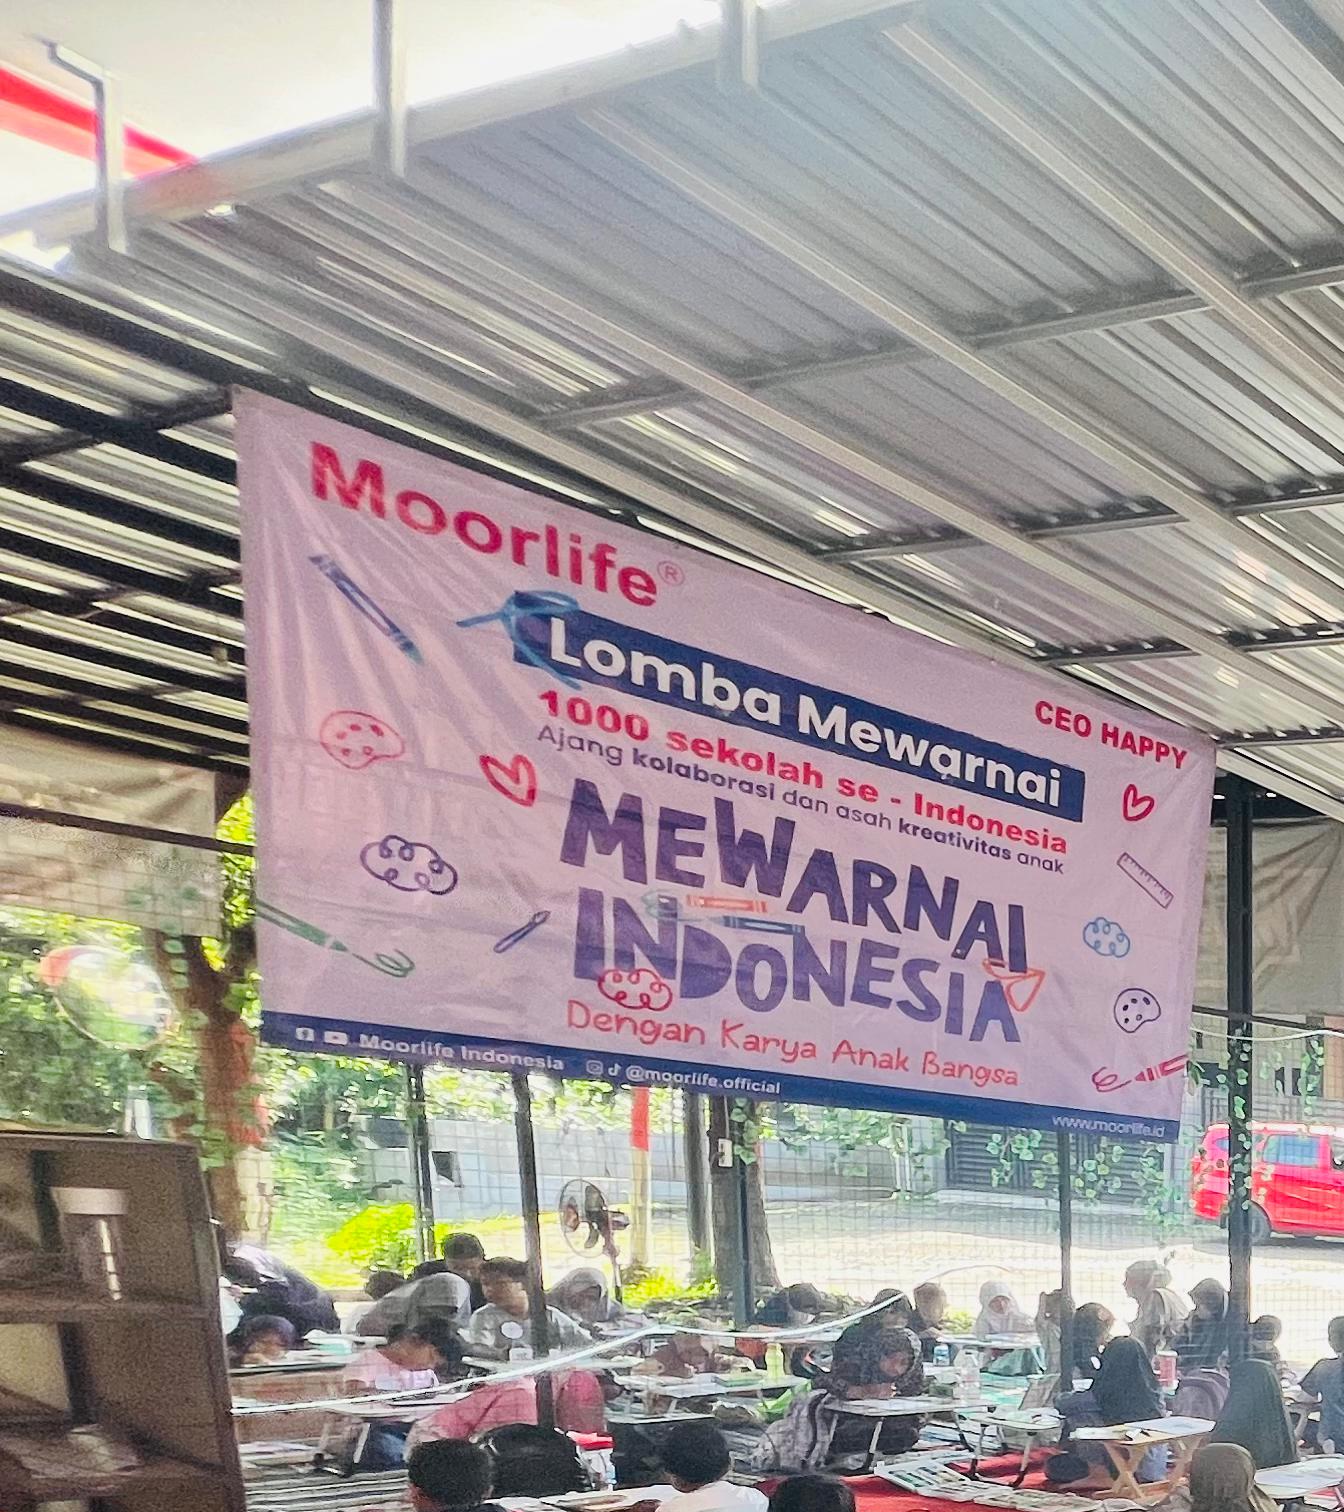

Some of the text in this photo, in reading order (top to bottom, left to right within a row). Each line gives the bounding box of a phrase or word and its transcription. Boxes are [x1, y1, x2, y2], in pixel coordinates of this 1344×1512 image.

[538, 689, 649, 741] 1000
[666, 727, 823, 789] sekolah
[836, 772, 878, 803] se
[914, 793, 1067, 853] Indonesia
[551, 618, 1061, 806] Lomba Mewarnai
[1035, 701, 1187, 769] CEO HAPPY
[538, 725, 1064, 874] Ajang kolaborasi dan asah kreativitas anak
[560, 778, 1028, 973] MEWARNAI
[574, 888, 1020, 1042] INDONESIA
[360, 1033, 564, 1071] Moorlife Indonesia
[566, 1000, 1019, 1087] Dengan Karya Anak Bangsa
[626, 1064, 780, 1095] @moorlife.official
[1053, 1116, 1165, 1138] www.moorlife.id
